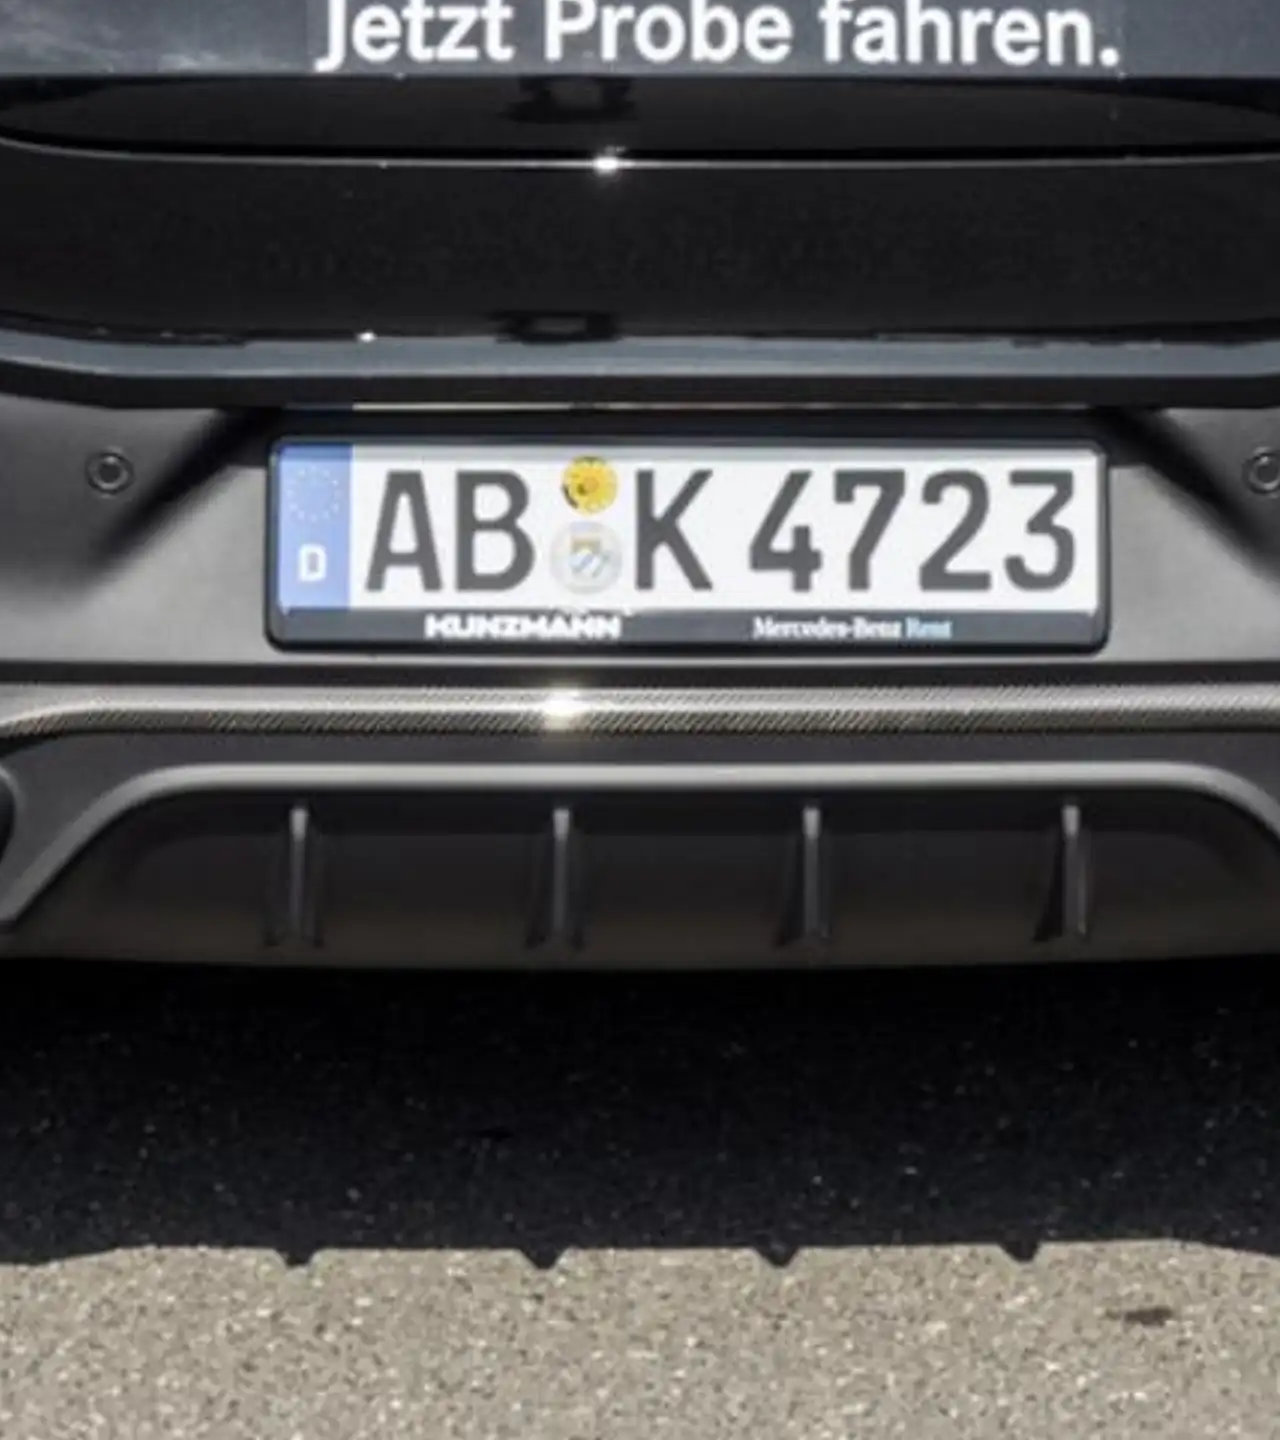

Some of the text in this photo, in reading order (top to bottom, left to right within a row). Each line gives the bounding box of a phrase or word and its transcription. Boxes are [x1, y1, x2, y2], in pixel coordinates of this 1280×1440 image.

[297, 469, 1076, 592] D AB K 4723
[424, 612, 621, 640] KUNZMANN
[752, 615, 903, 640] Mercedes-Benz
